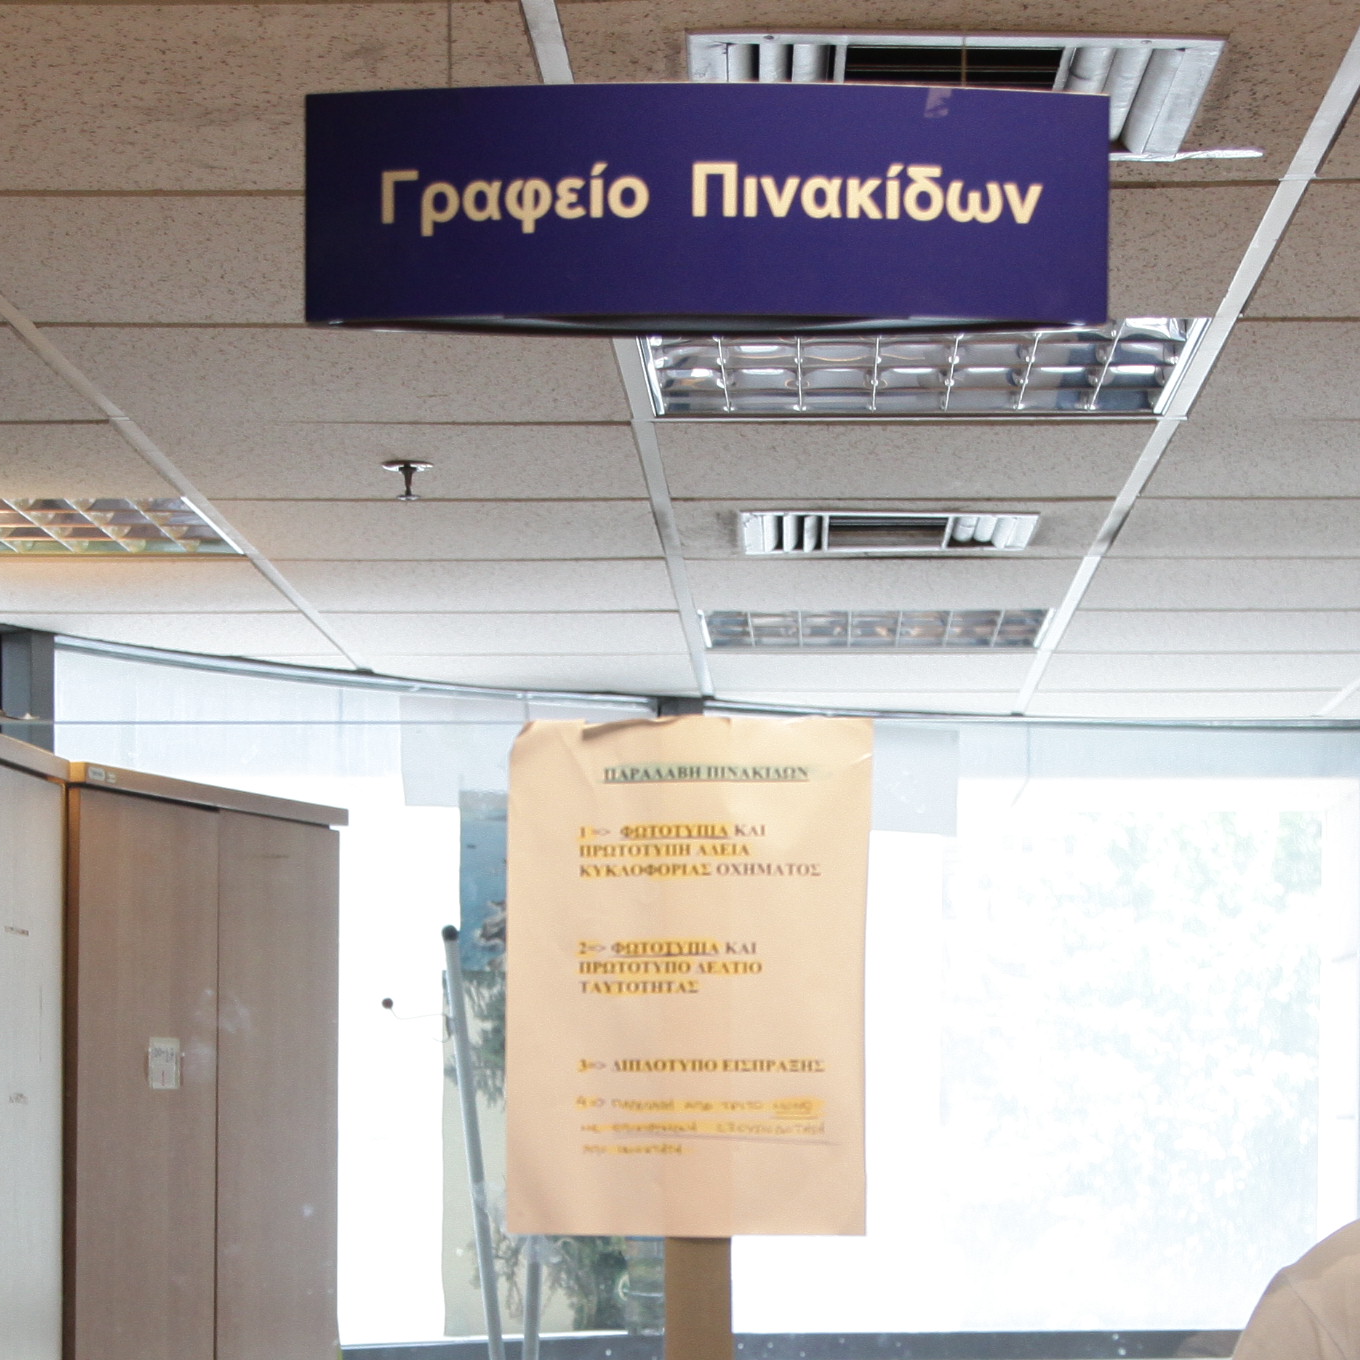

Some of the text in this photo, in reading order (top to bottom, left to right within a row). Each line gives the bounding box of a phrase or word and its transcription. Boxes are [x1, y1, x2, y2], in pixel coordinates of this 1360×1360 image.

[381, 162, 1043, 237] Γραφείο Πινακίδων
[604, 766, 809, 782] ΠΑΡΑΛΑΒΗ ΠΙΝΑΚΙΔΩΝ
[620, 824, 729, 839] ΦΩΤΟΤΥΠΙΑ
[734, 824, 766, 837] ΚΑΙ
[579, 844, 750, 858] ΠΡΩΤΟΤΥΠΗ ΑΔΕΙΑ
[579, 863, 821, 877] ΚΥΚΛΟΦΟΡΙΑΣ ΟΧΗΜΑΤΟΣ
[610, 941, 719, 956] ΦΩΤΟΤΥΠΙΑ
[725, 942, 757, 955] ΚΑΙ
[579, 961, 763, 975] ΠΡΩΤΟΤΥΠΟ ΔΕΛΤΙΟ
[579, 980, 699, 994] ΤΑΥΤΟΤΗΤΑΣ
[611, 1059, 717, 1073] ΔΙΠΛΟΤΥΠΟ
[722, 1059, 826, 1073] ΕΙΣΠΡΑΞΗΣ
